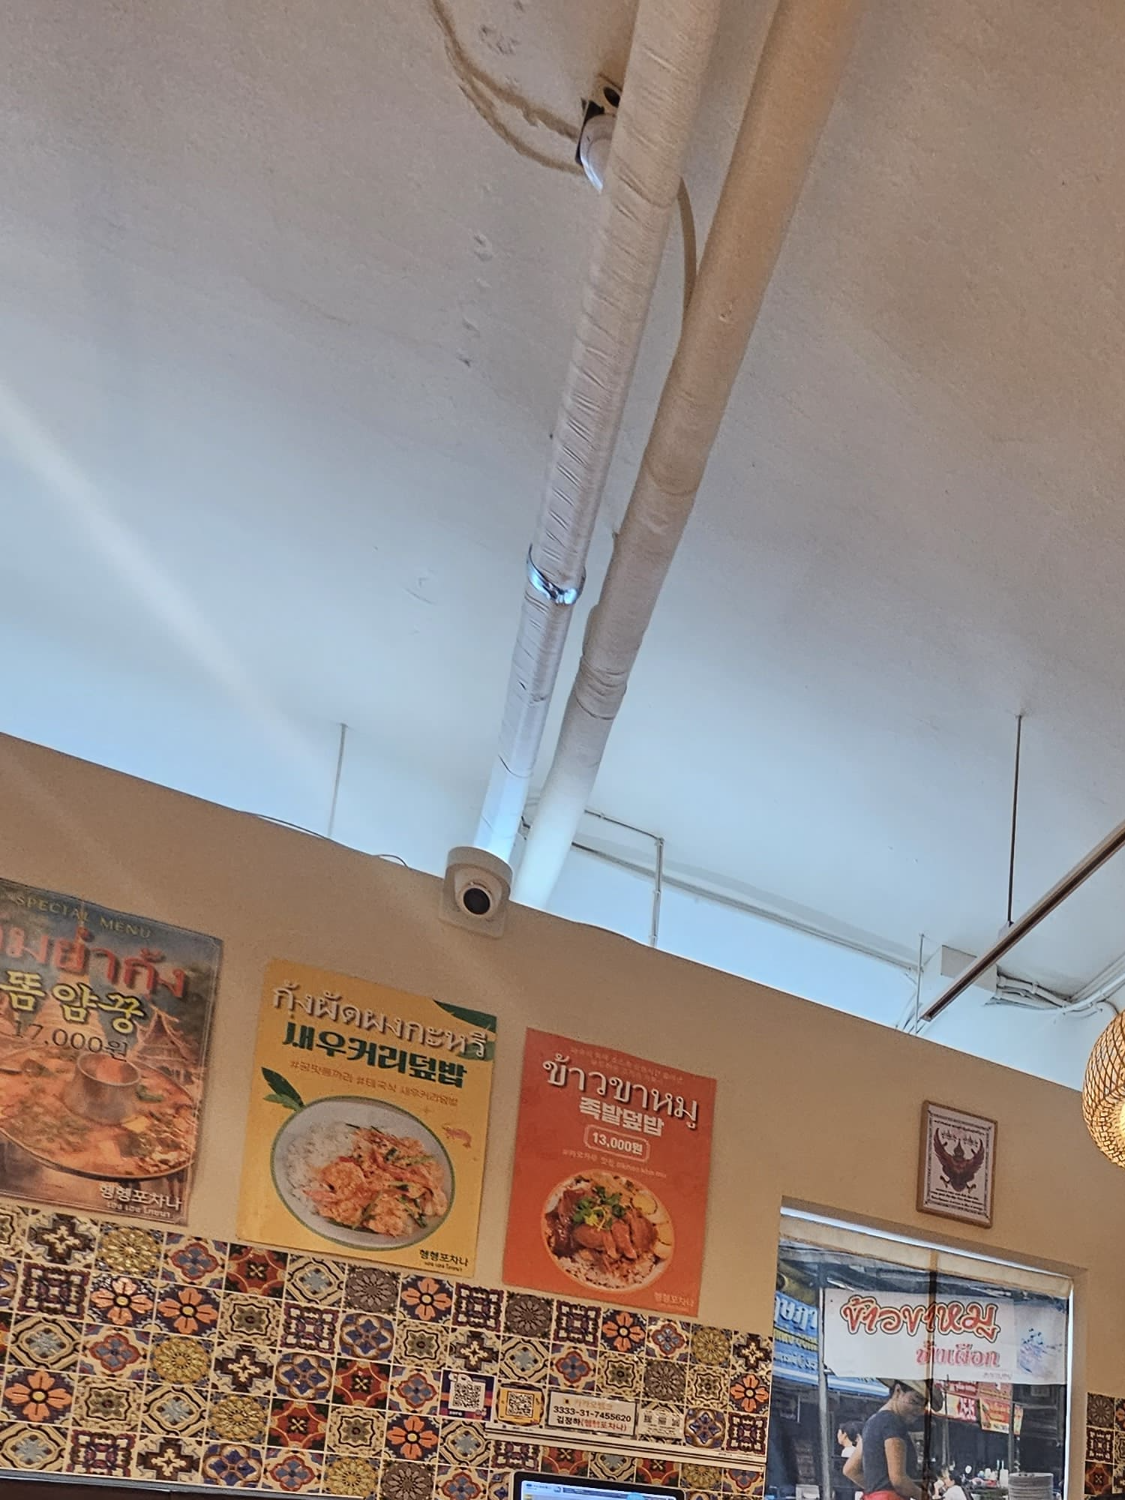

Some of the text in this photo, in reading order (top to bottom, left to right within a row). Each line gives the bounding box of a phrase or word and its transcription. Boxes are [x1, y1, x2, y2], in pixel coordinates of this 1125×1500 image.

[15, 897, 151, 939] SPECIAL MENU
[0, 925, 187, 1001] มยำกุ้ง
[282, 1021, 468, 1089] 새우커리덮밥
[543, 1053, 699, 1129] ข้าวขาหมู
[579, 1096, 665, 1137] 족발덮밥
[592, 1131, 643, 1156] 13,000원
[100, 1184, 183, 1211] 헹헹포차나
[840, 1294, 1001, 1343] ข้าวขาหมู
[553, 1405, 632, 1423] 3333-31-7455620
